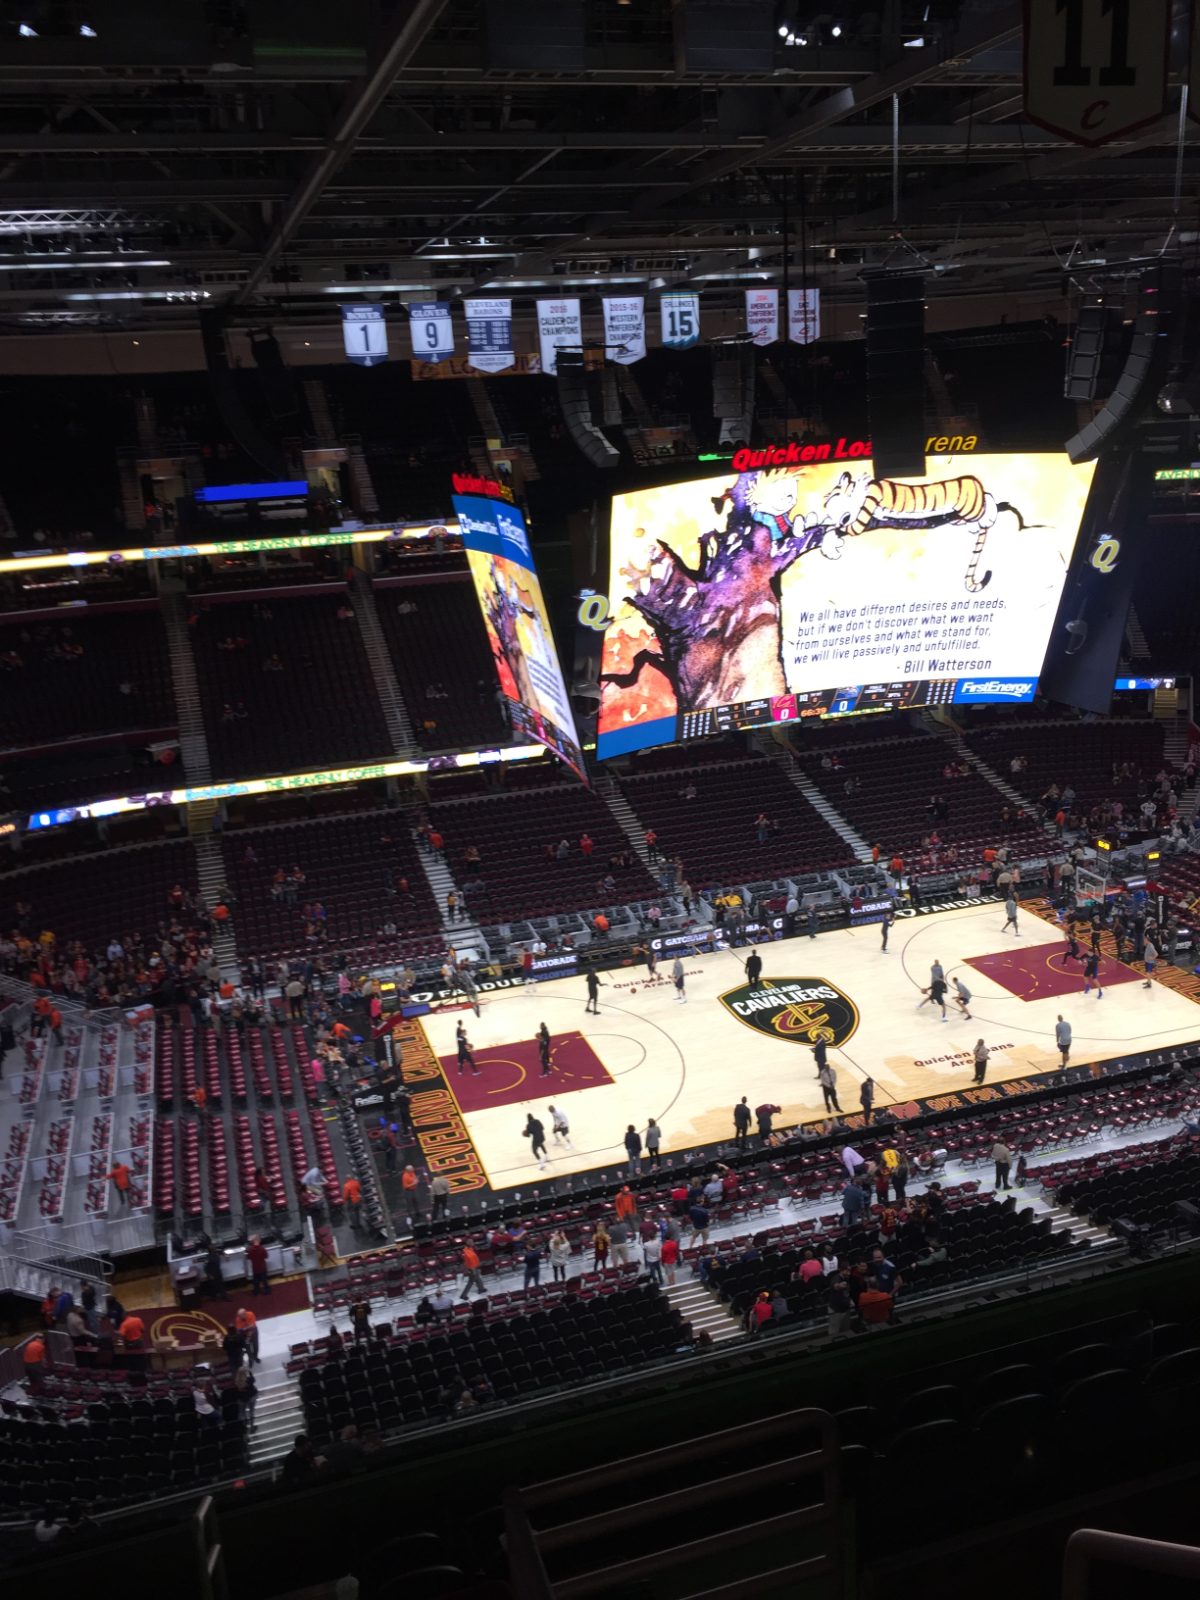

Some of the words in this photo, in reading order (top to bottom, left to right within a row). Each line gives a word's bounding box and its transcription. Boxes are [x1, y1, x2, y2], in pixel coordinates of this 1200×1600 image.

[1054, 0, 1136, 86] 11
[426, 322, 438, 348] 9
[669, 311, 693, 337] 15
[360, 324, 370, 352] 1
[732, 441, 830, 472] Quicken
[838, 438, 873, 460] Loa
[925, 434, 977, 452] rena
[1091, 540, 1120, 573] Q
[578, 595, 611, 631] Q
[800, 611, 815, 623] We
[817, 608, 831, 621] all
[833, 608, 857, 619] have
[860, 604, 906, 617] different
[908, 601, 948, 613] desires
[951, 599, 972, 610] and
[797, 626, 815, 637] but
[817, 623, 826, 635] if
[828, 624, 843, 633] we
[846, 619, 872, 632] don't
[874, 616, 918, 629] discover
[921, 614, 947, 625] what
[950, 614, 965, 624] we
[968, 613, 994, 623] want
[796, 639, 820, 651] from
[822, 633, 872, 648] ourselves
[874, 631, 893, 642] and
[896, 629, 921, 640] what
[924, 629, 939, 638] we
[941, 626, 972, 638] stand
[794, 654, 808, 664] we
[811, 649, 830, 662] will
[832, 648, 850, 659] live
[853, 644, 900, 660] passively
[903, 642, 922, 653] and
[904, 660, 925, 673] Bill
[928, 659, 992, 672] Watterson
[781, 709, 789, 719] 0
[839, 701, 848, 711] 0
[919, 894, 1004, 914] FANDUEL
[773, 918, 783, 929] G
[651, 938, 662, 950] G
[732, 986, 840, 1016] CAVALIERS
[749, 984, 802, 998] CLEVELAND
[913, 1051, 972, 1067] Quicken
[409, 1088, 488, 1195] CLEVELAND
